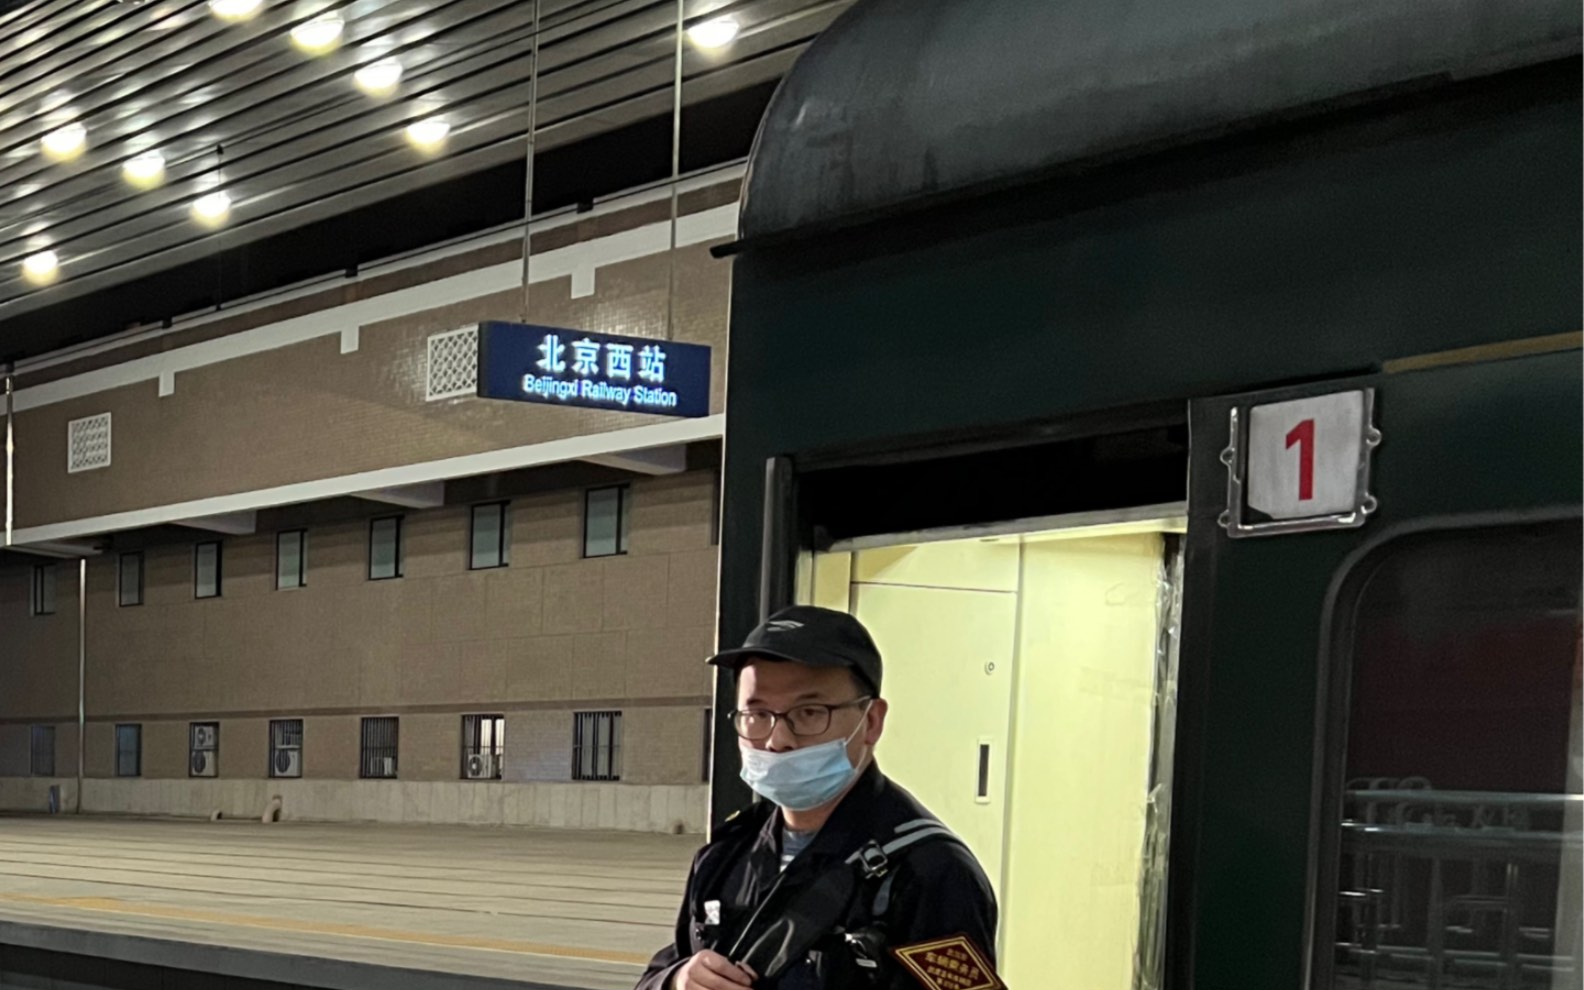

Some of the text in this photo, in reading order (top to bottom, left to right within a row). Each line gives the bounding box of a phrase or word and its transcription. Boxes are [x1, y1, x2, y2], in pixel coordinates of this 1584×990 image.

[537, 334, 666, 382] 北京西站
[523, 374, 678, 407] Beijingxi Railway Station
[1285, 418, 1314, 501] 1
